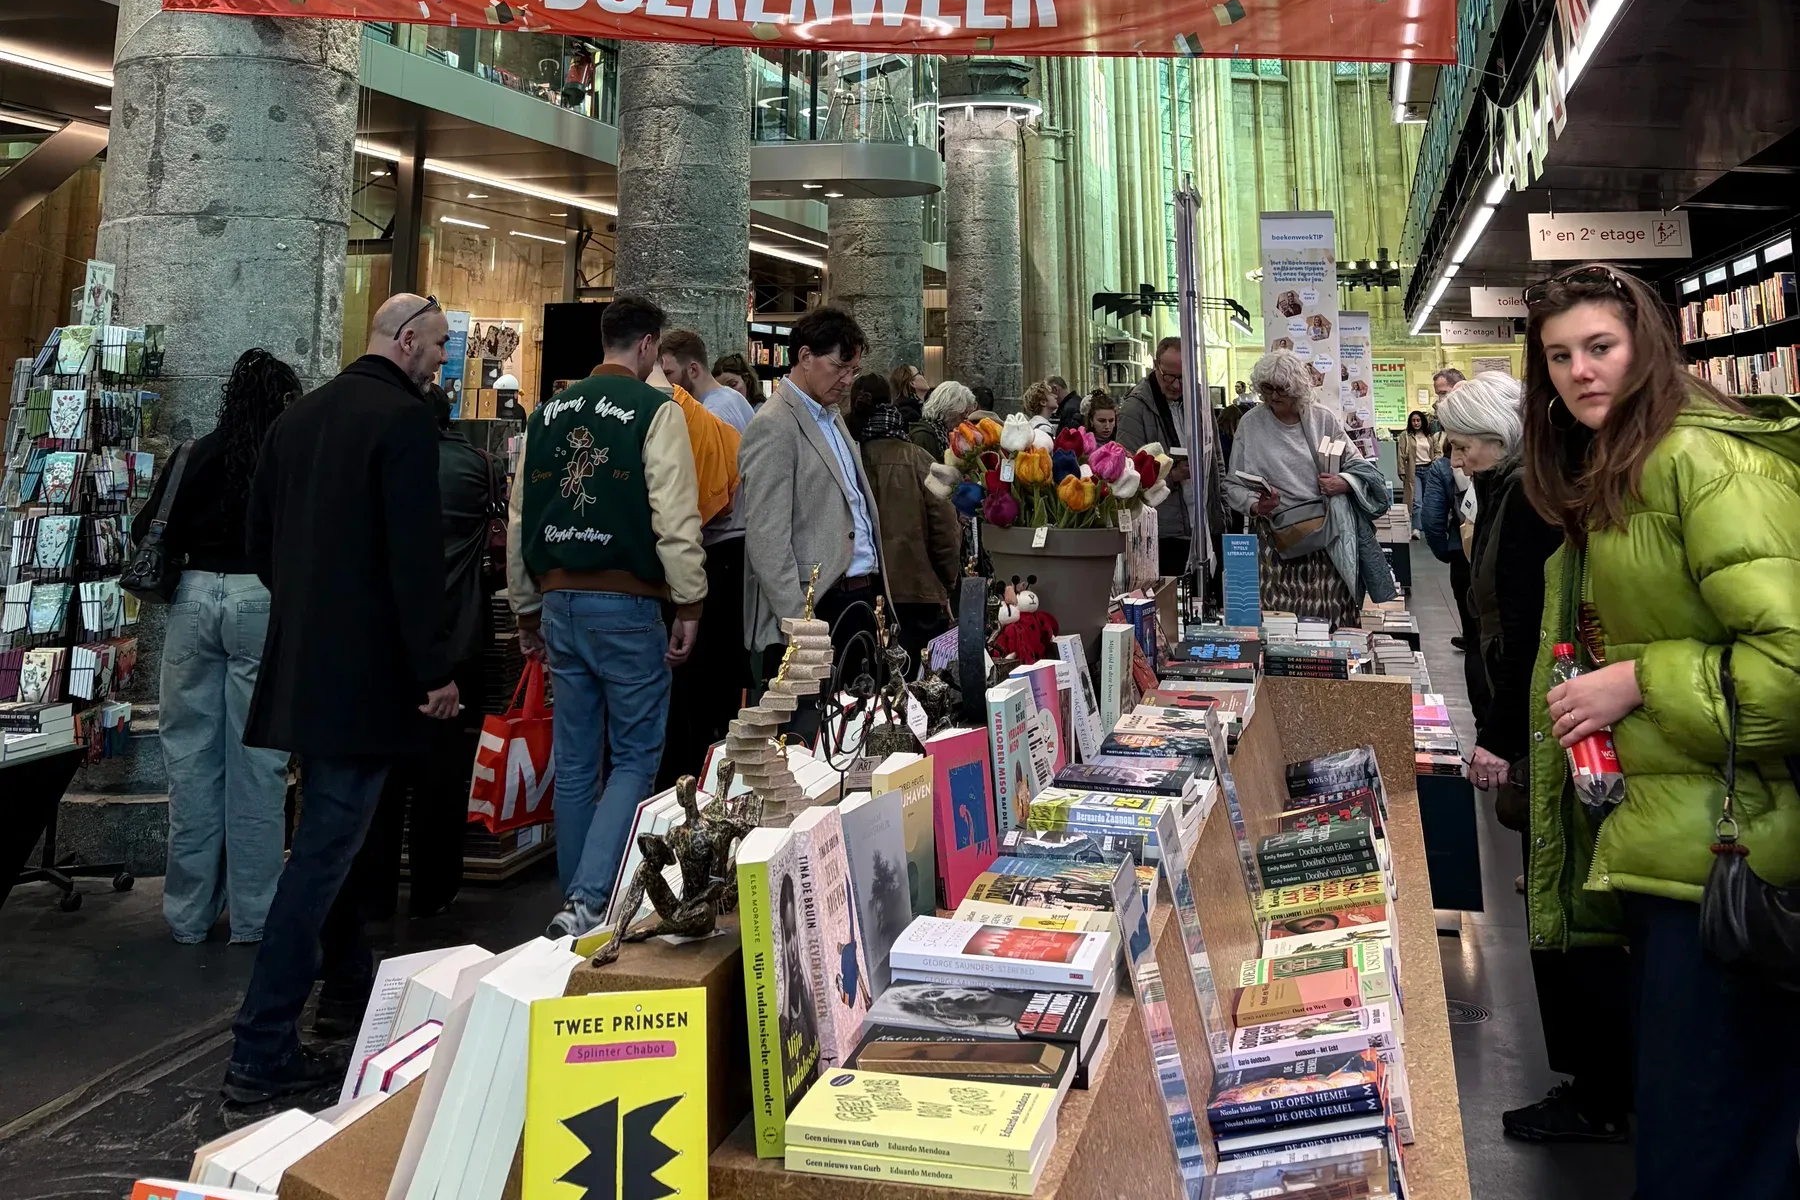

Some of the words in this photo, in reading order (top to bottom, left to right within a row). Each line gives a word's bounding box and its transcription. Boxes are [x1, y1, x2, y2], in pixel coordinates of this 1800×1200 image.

[1556, 231, 1575, 241] en
[1600, 229, 1646, 244] etage
[543, 396, 586, 426] Never
[595, 395, 636, 425] break
[575, 527, 613, 546] nothing
[1107, 640, 1115, 653] Mijn
[994, 711, 1005, 764] VERLOREN
[1008, 721, 1026, 740] VERLOREN
[1080, 728, 1090, 750] KEUZE
[998, 765, 1006, 794] MISO
[1002, 811, 1008, 820] DE
[1076, 811, 1105, 823] Bernardo
[1105, 812, 1135, 825] Zannoni
[1137, 816, 1152, 827] 25
[1264, 853, 1276, 861] Emily
[1298, 844, 1323, 857] Doolhof
[1323, 844, 1334, 853] van
[1334, 841, 1350, 852] Eden
[798, 855, 808, 881] TINA
[1267, 864, 1279, 873] Emily
[1301, 856, 1326, 868] Doolhof
[1326, 856, 1337, 865] van
[1337, 852, 1354, 863] Eden
[1270, 877, 1283, 885] Emily
[1305, 868, 1330, 881] Doolhof
[1330, 868, 1341, 877] van
[1341, 865, 1357, 876] Eden
[802, 881, 812, 896] DE
[752, 899, 761, 943] MORANTE
[804, 898, 817, 929] BRUIN
[1271, 913, 1283, 921] KEVIN
[1283, 909, 1302, 919] LAMBERT
[1303, 908, 1313, 916] LAAT
[1313, 906, 1325, 914] ONZE
[1325, 903, 1344, 913] VREUGDE
[808, 938, 823, 971] ZEVEN
[922, 958, 953, 968] GEORGE
[954, 961, 994, 972] SAUNDERS
[753, 952, 764, 980] Mijn
[924, 976, 954, 985] GEORGE
[813, 972, 829, 1019] BRIEVEN
[1292, 1006, 1305, 1014] Oost
[554, 1017, 604, 1036] TWEE
[613, 1011, 688, 1032] PRINSEN
[756, 982, 771, 1064] Andalusische
[577, 1047, 621, 1059] Splinter
[626, 1044, 665, 1055] Chabot
[786, 1031, 803, 1060] Mijn
[1238, 1057, 1250, 1066] Dario
[1250, 1055, 1271, 1064] Goldbach
[1295, 1048, 1315, 1057] Goldband
[1295, 1059, 1305, 1074] OPEN
[1307, 1056, 1318, 1073] HEMEL
[1284, 1064, 1294, 1074] DE
[762, 1067, 773, 1117] moeder
[1220, 1107, 1239, 1117] Nicolas
[1240, 1104, 1262, 1115] Mathieu
[1270, 1100, 1284, 1110] DE
[1286, 1094, 1315, 1107] OPEN
[1316, 1089, 1351, 1103] HEMEL
[999, 1113, 1019, 1139] Eduardo
[1013, 1092, 1031, 1117] Mendoza
[1224, 1119, 1244, 1129] Nicolas
[1244, 1116, 1266, 1125] Mathieu
[1274, 1112, 1289, 1123] DE
[1290, 1107, 1318, 1120] OPEN
[1319, 1102, 1355, 1116] HEMEL
[804, 1133, 822, 1143] Geen
[822, 1135, 847, 1145] nieuws
[848, 1139, 861, 1147] van
[861, 1138, 879, 1148] Gurb
[888, 1142, 918, 1153] Eduardo
[918, 1145, 950, 1156] Mendoza
[805, 1158, 823, 1168] Geen
[823, 1160, 848, 1170] nieuws
[863, 1163, 881, 1173] Gurb
[890, 1166, 920, 1177] Eduardo
[921, 1169, 953, 1179] Mendoza
